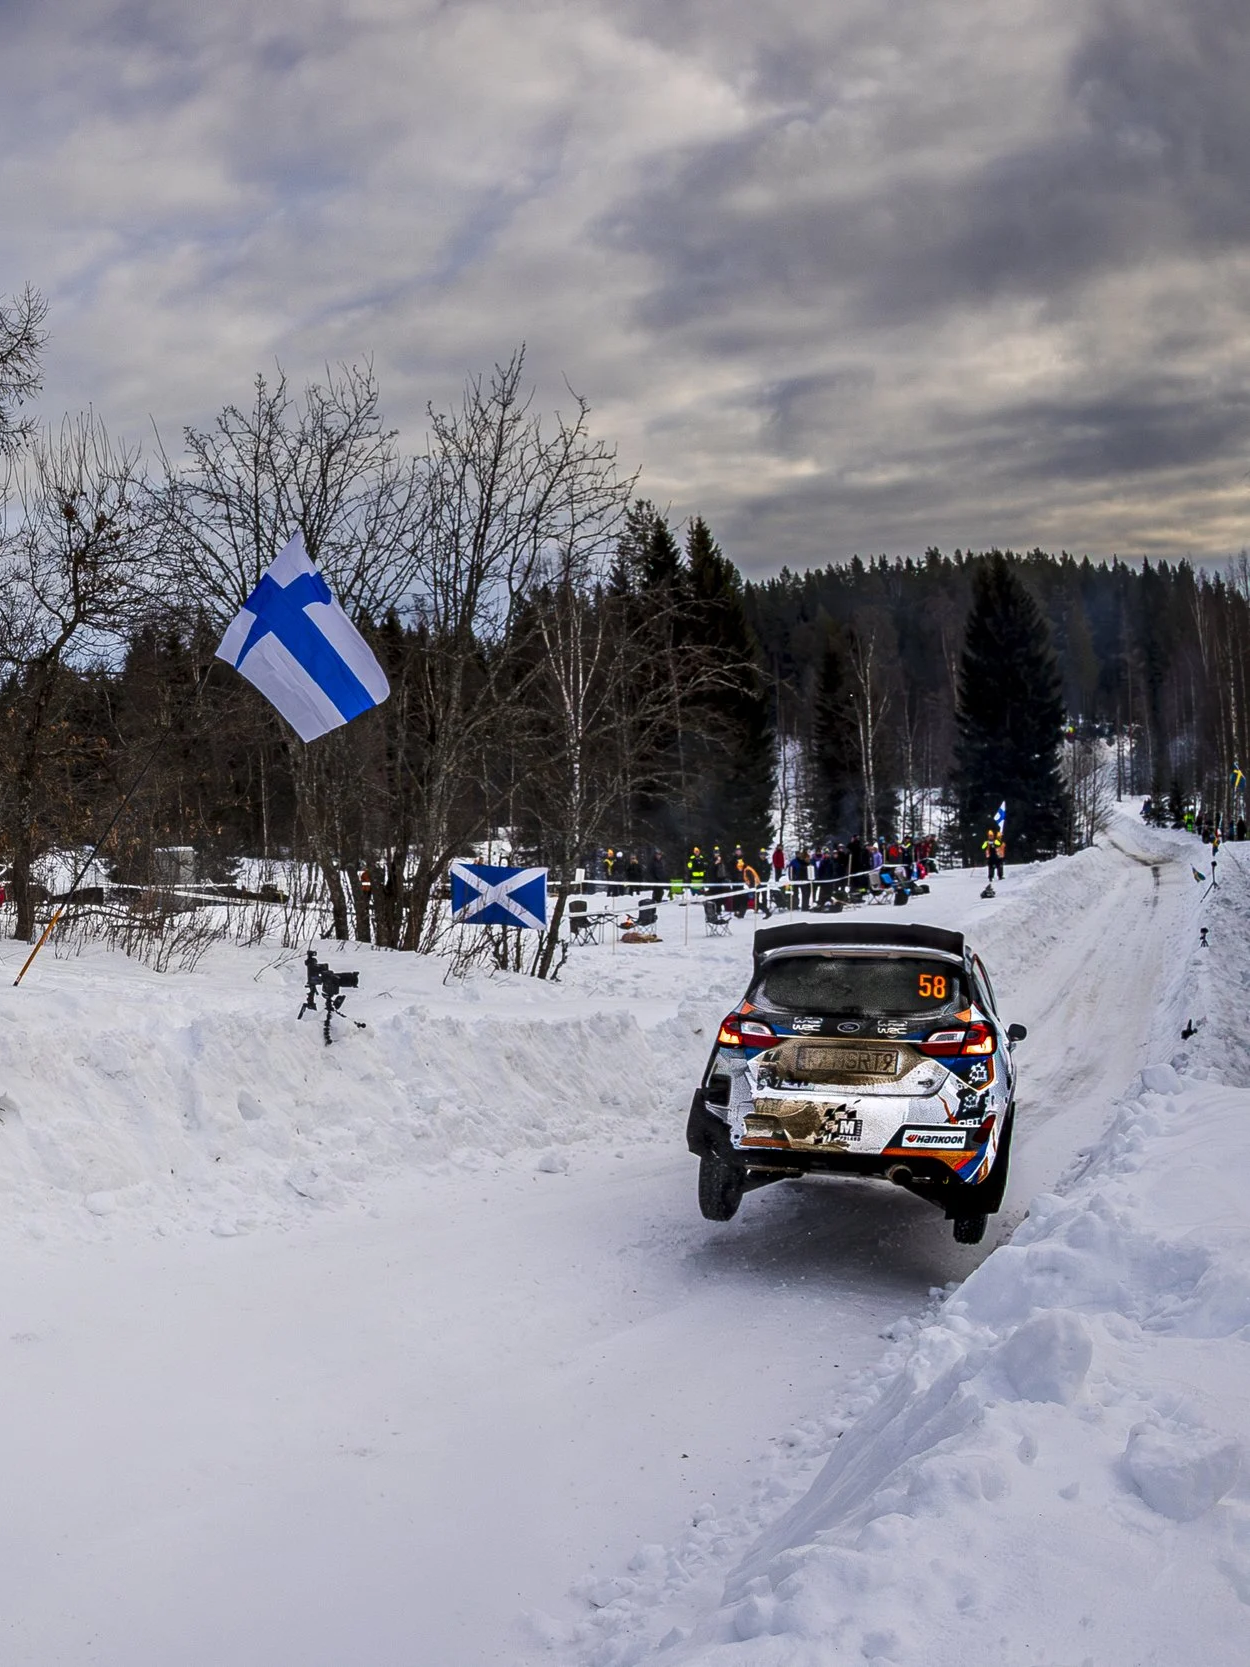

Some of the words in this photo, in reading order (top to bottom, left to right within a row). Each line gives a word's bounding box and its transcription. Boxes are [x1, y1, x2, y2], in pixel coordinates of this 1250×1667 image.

[918, 974, 946, 999] 58
[792, 1023, 821, 1032] WRC
[877, 1027, 908, 1035] WRC
[839, 1120, 856, 1135] M
